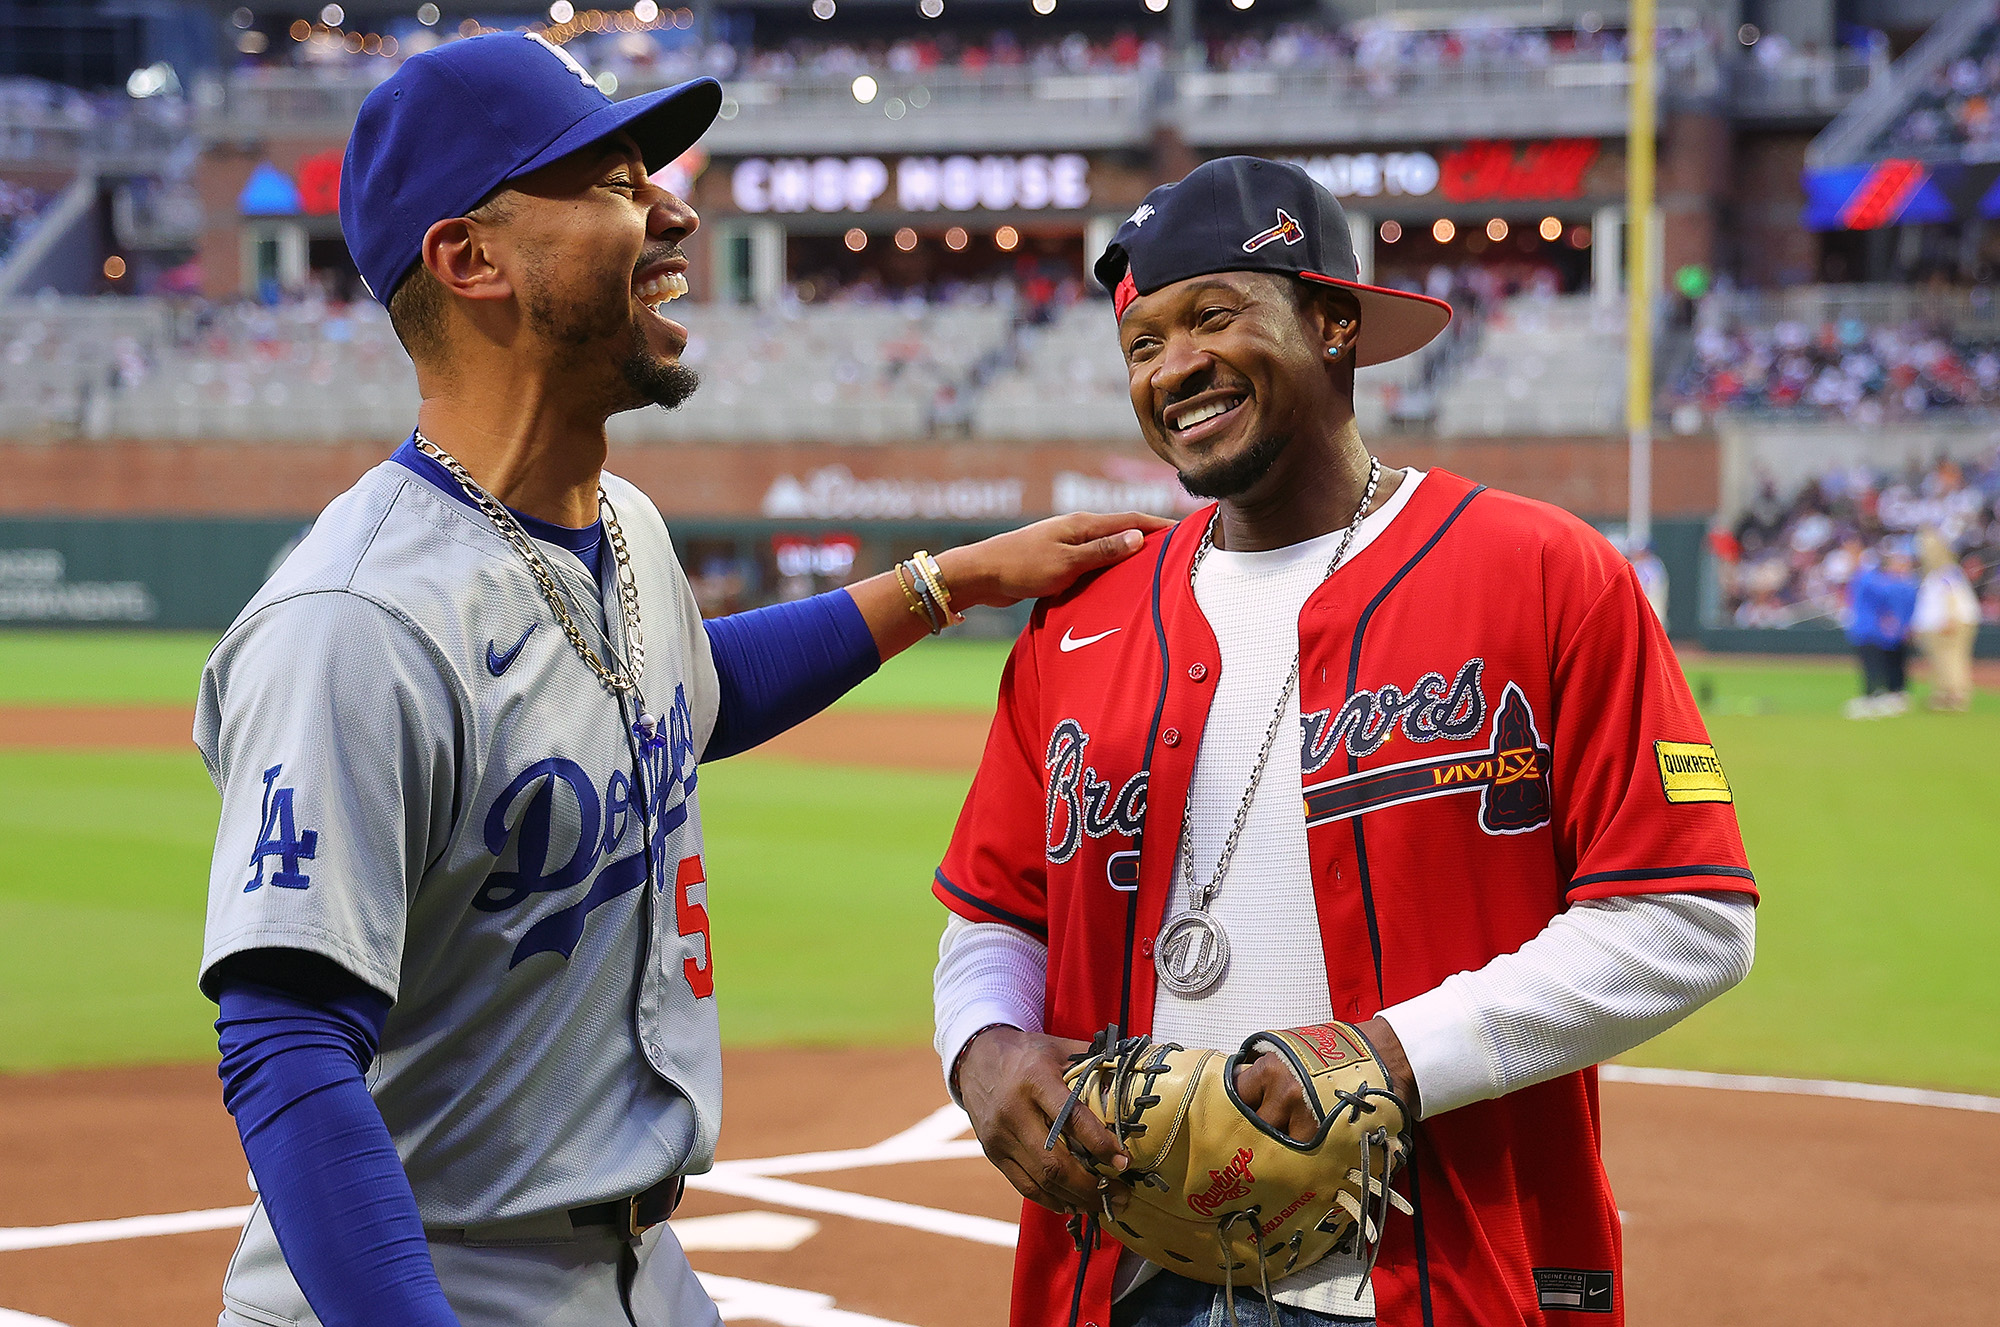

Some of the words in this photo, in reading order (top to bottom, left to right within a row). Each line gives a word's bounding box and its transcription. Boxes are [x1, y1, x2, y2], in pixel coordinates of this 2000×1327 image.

[731, 157, 888, 213] CHOP
[897, 154, 1091, 212] HOUSE
[1664, 754, 1721, 776] QUIKRETE
[243, 763, 319, 893] LA
[1187, 1147, 1255, 1216] Rawlings
[1540, 1273, 1582, 1281] ENGINEERED
